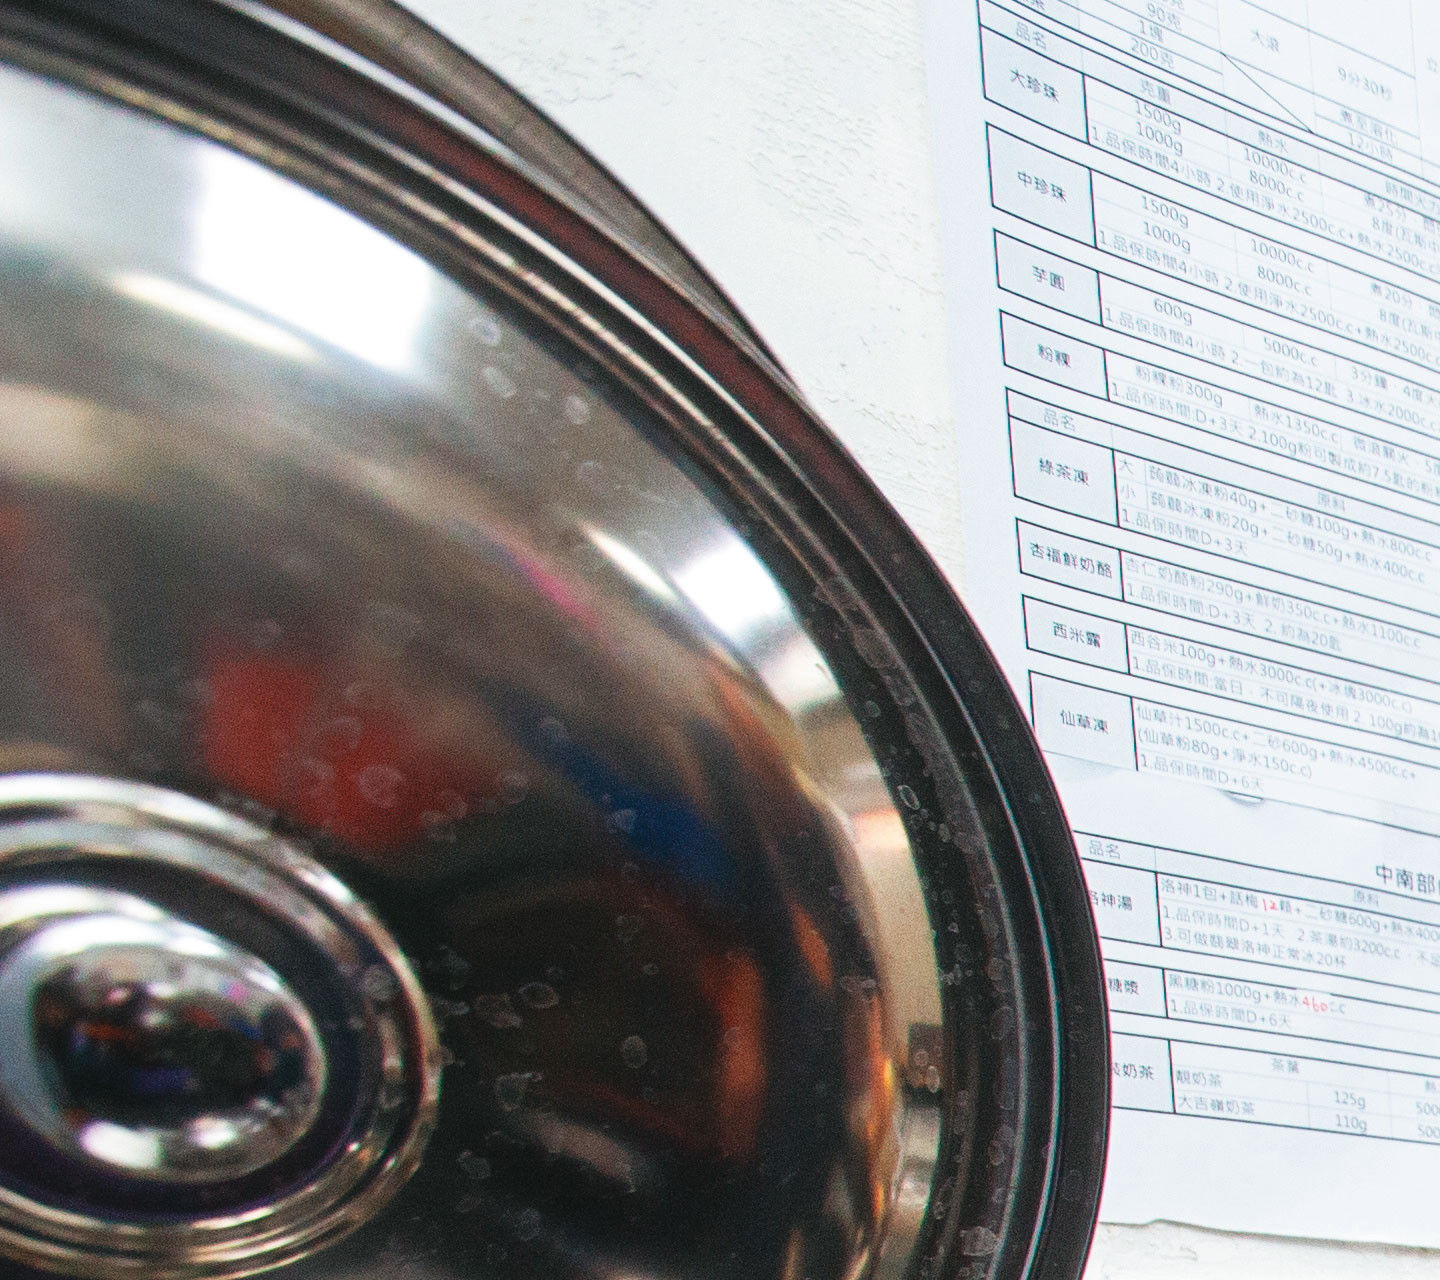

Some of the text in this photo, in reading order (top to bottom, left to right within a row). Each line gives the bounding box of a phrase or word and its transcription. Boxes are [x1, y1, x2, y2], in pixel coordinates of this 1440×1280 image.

[1016, 21, 1048, 50] 品名
[1130, 38, 1176, 70] 200克
[1010, 67, 1060, 103] 大珍珠
[1134, 100, 1182, 135] 1500g
[1136, 121, 1183, 157] 1000g
[1243, 147, 1310, 185] 10000c.c
[1017, 171, 1068, 204] 中珍珠
[1249, 169, 1306, 203] 8000c.c
[1142, 196, 1190, 229] 1500g
[1143, 221, 1192, 254] 1000g
[1250, 238, 1316, 275] 10000c.c
[1032, 264, 1066, 292] 芋圓
[1257, 265, 1313, 297] 8000c.c
[1153, 297, 1194, 327] 600g
[1263, 336, 1319, 368] 5000c.c
[1044, 407, 1077, 432] 品名
[1039, 457, 1089, 487] 綠茶凍
[1118, 458, 1134, 476] 大
[1120, 484, 1137, 501] 小
[1030, 541, 1113, 580] 杏福鮮奶酪
[1053, 620, 1101, 649] 西米露
[1060, 709, 1109, 735] 仙草凍
[1089, 839, 1121, 860] 品名
[1112, 1061, 1155, 1081] 奶茶
[1271, 1058, 1301, 1075] 茶葉
[1178, 1094, 1257, 1117] 大吉嶺奶茶
[1334, 1090, 1367, 1111] 125g
[1335, 1113, 1368, 1135] 110g
